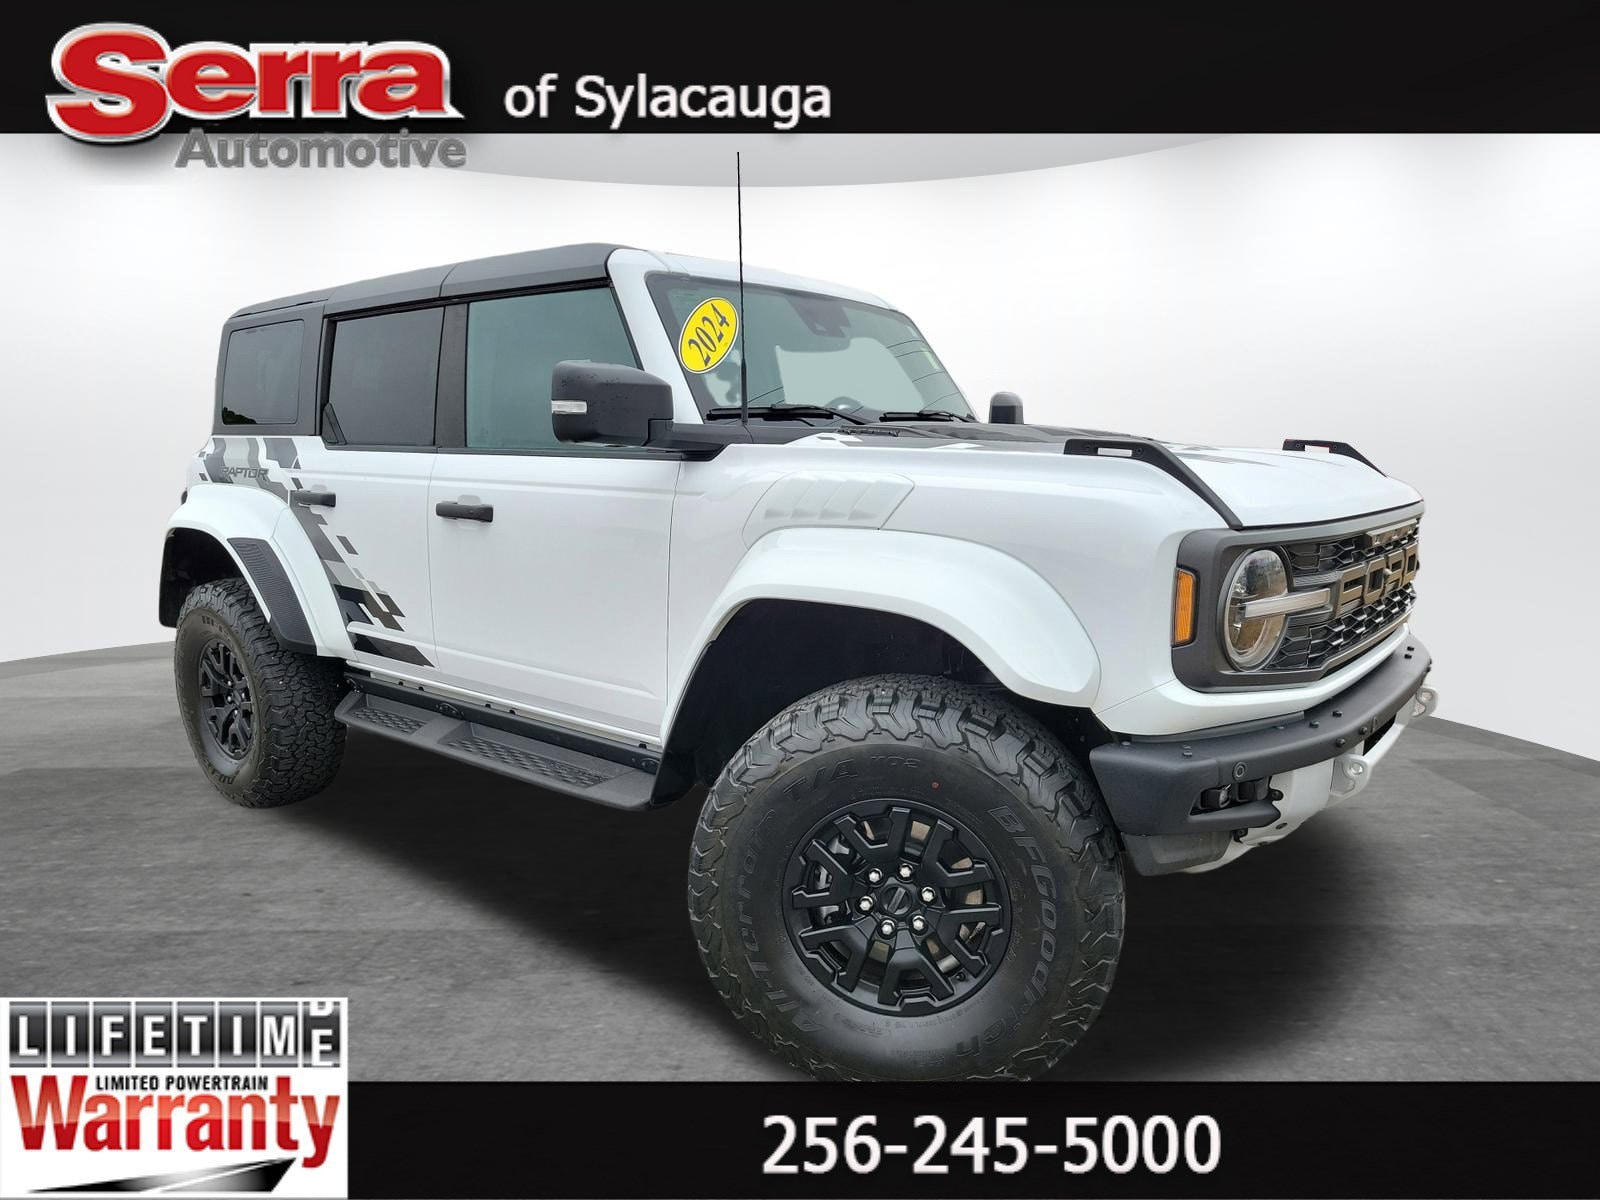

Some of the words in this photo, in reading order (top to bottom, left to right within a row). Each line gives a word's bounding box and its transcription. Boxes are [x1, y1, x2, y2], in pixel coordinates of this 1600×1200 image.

[687, 302, 730, 367] 2024
[221, 466, 269, 481] RAPTOR
[1336, 540, 1418, 619] FORD
